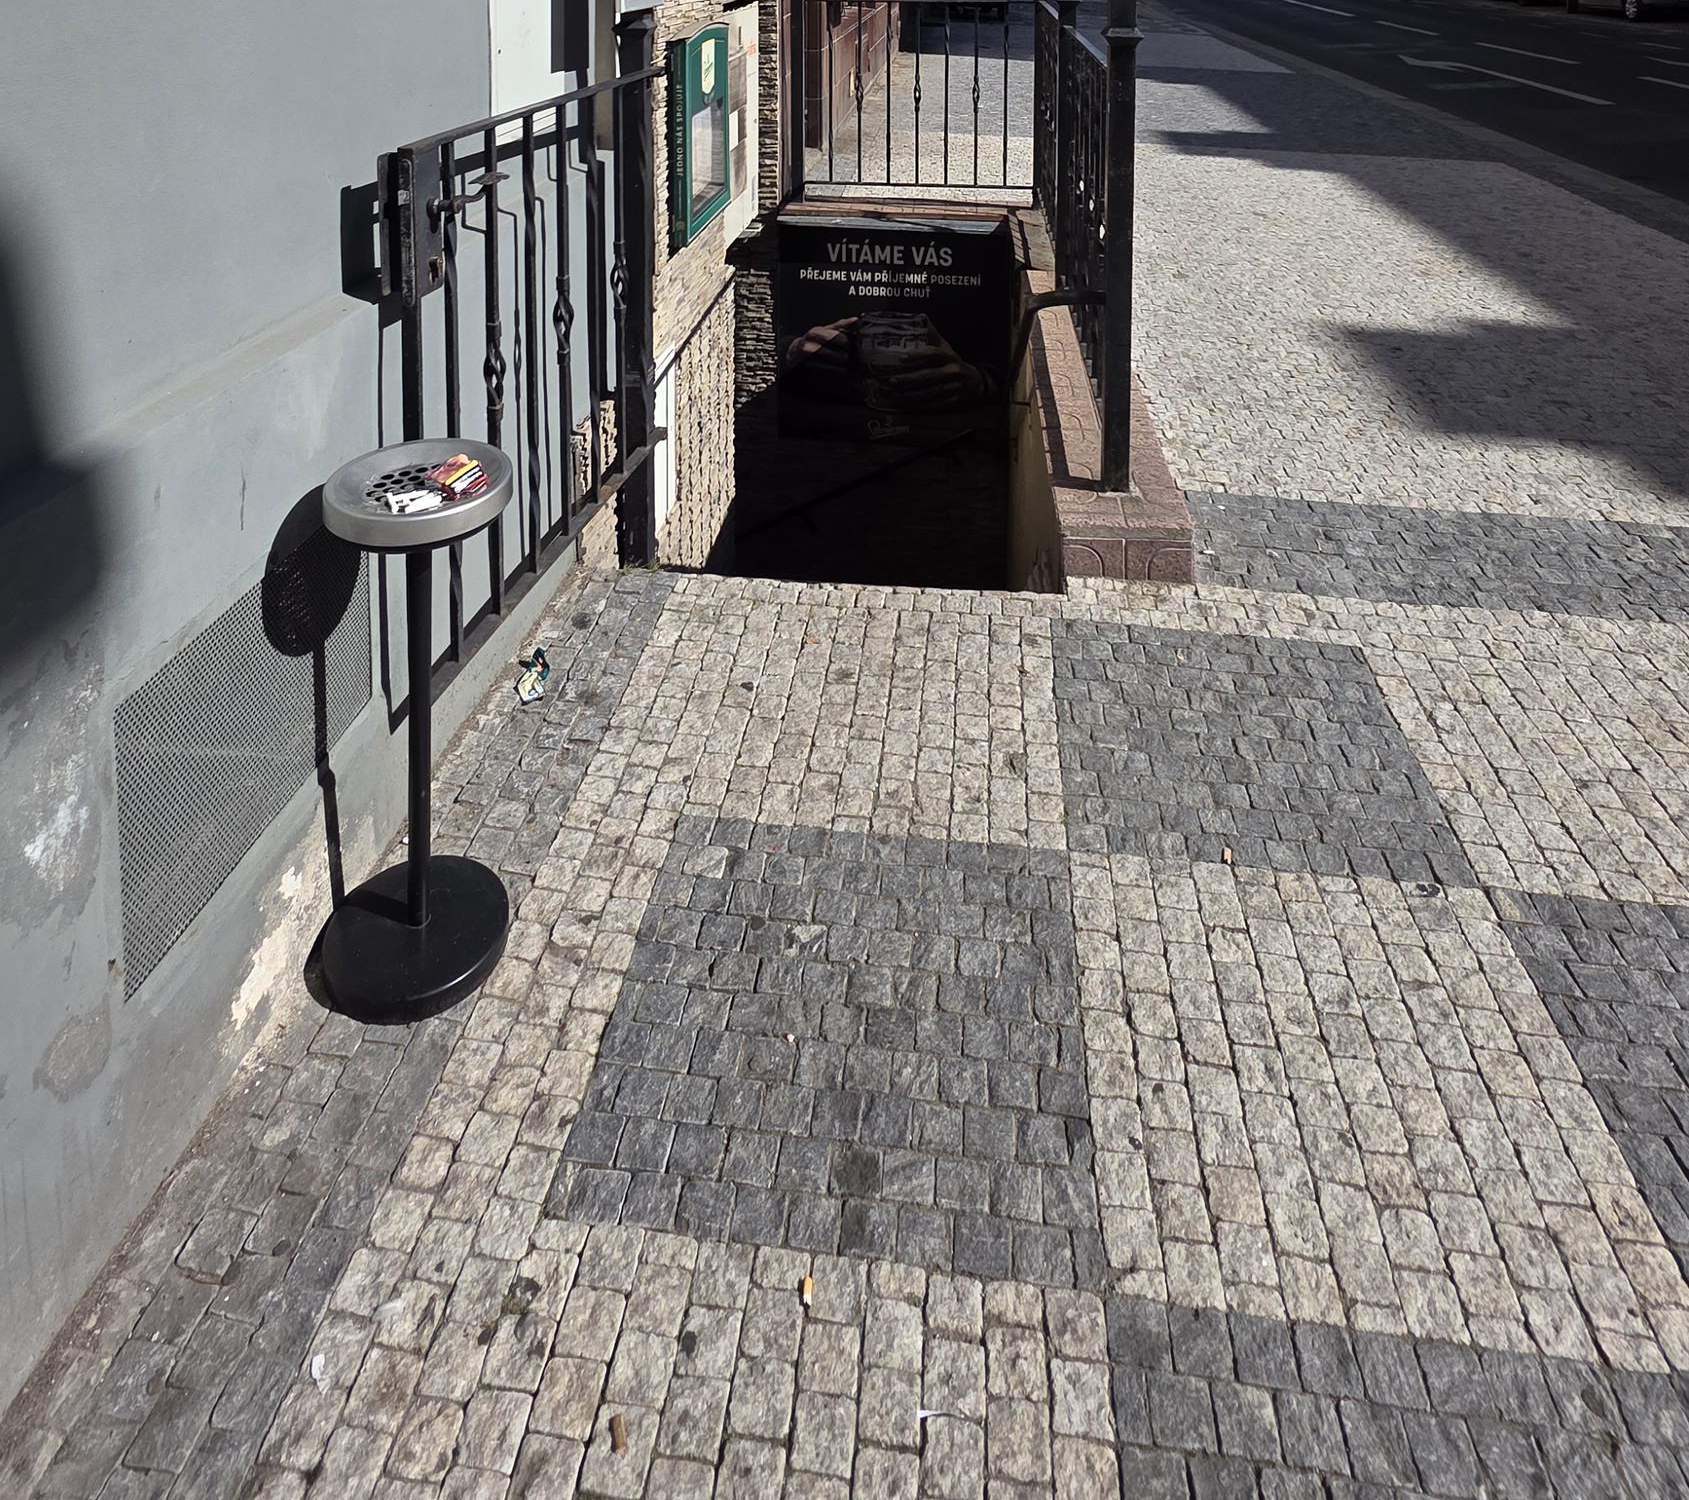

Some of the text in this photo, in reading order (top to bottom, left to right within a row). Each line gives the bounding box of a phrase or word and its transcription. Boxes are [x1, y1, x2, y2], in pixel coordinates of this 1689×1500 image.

[675, 84, 684, 177] JEDNO NÁS SPOJUJE
[827, 238, 953, 267] VÍTÁME VÁS
[800, 267, 981, 287] PŘEJEME VÁM PŘÍJEMNÉ POSEZENÍ
[848, 286, 930, 299] A DOBROU CHUŤ
